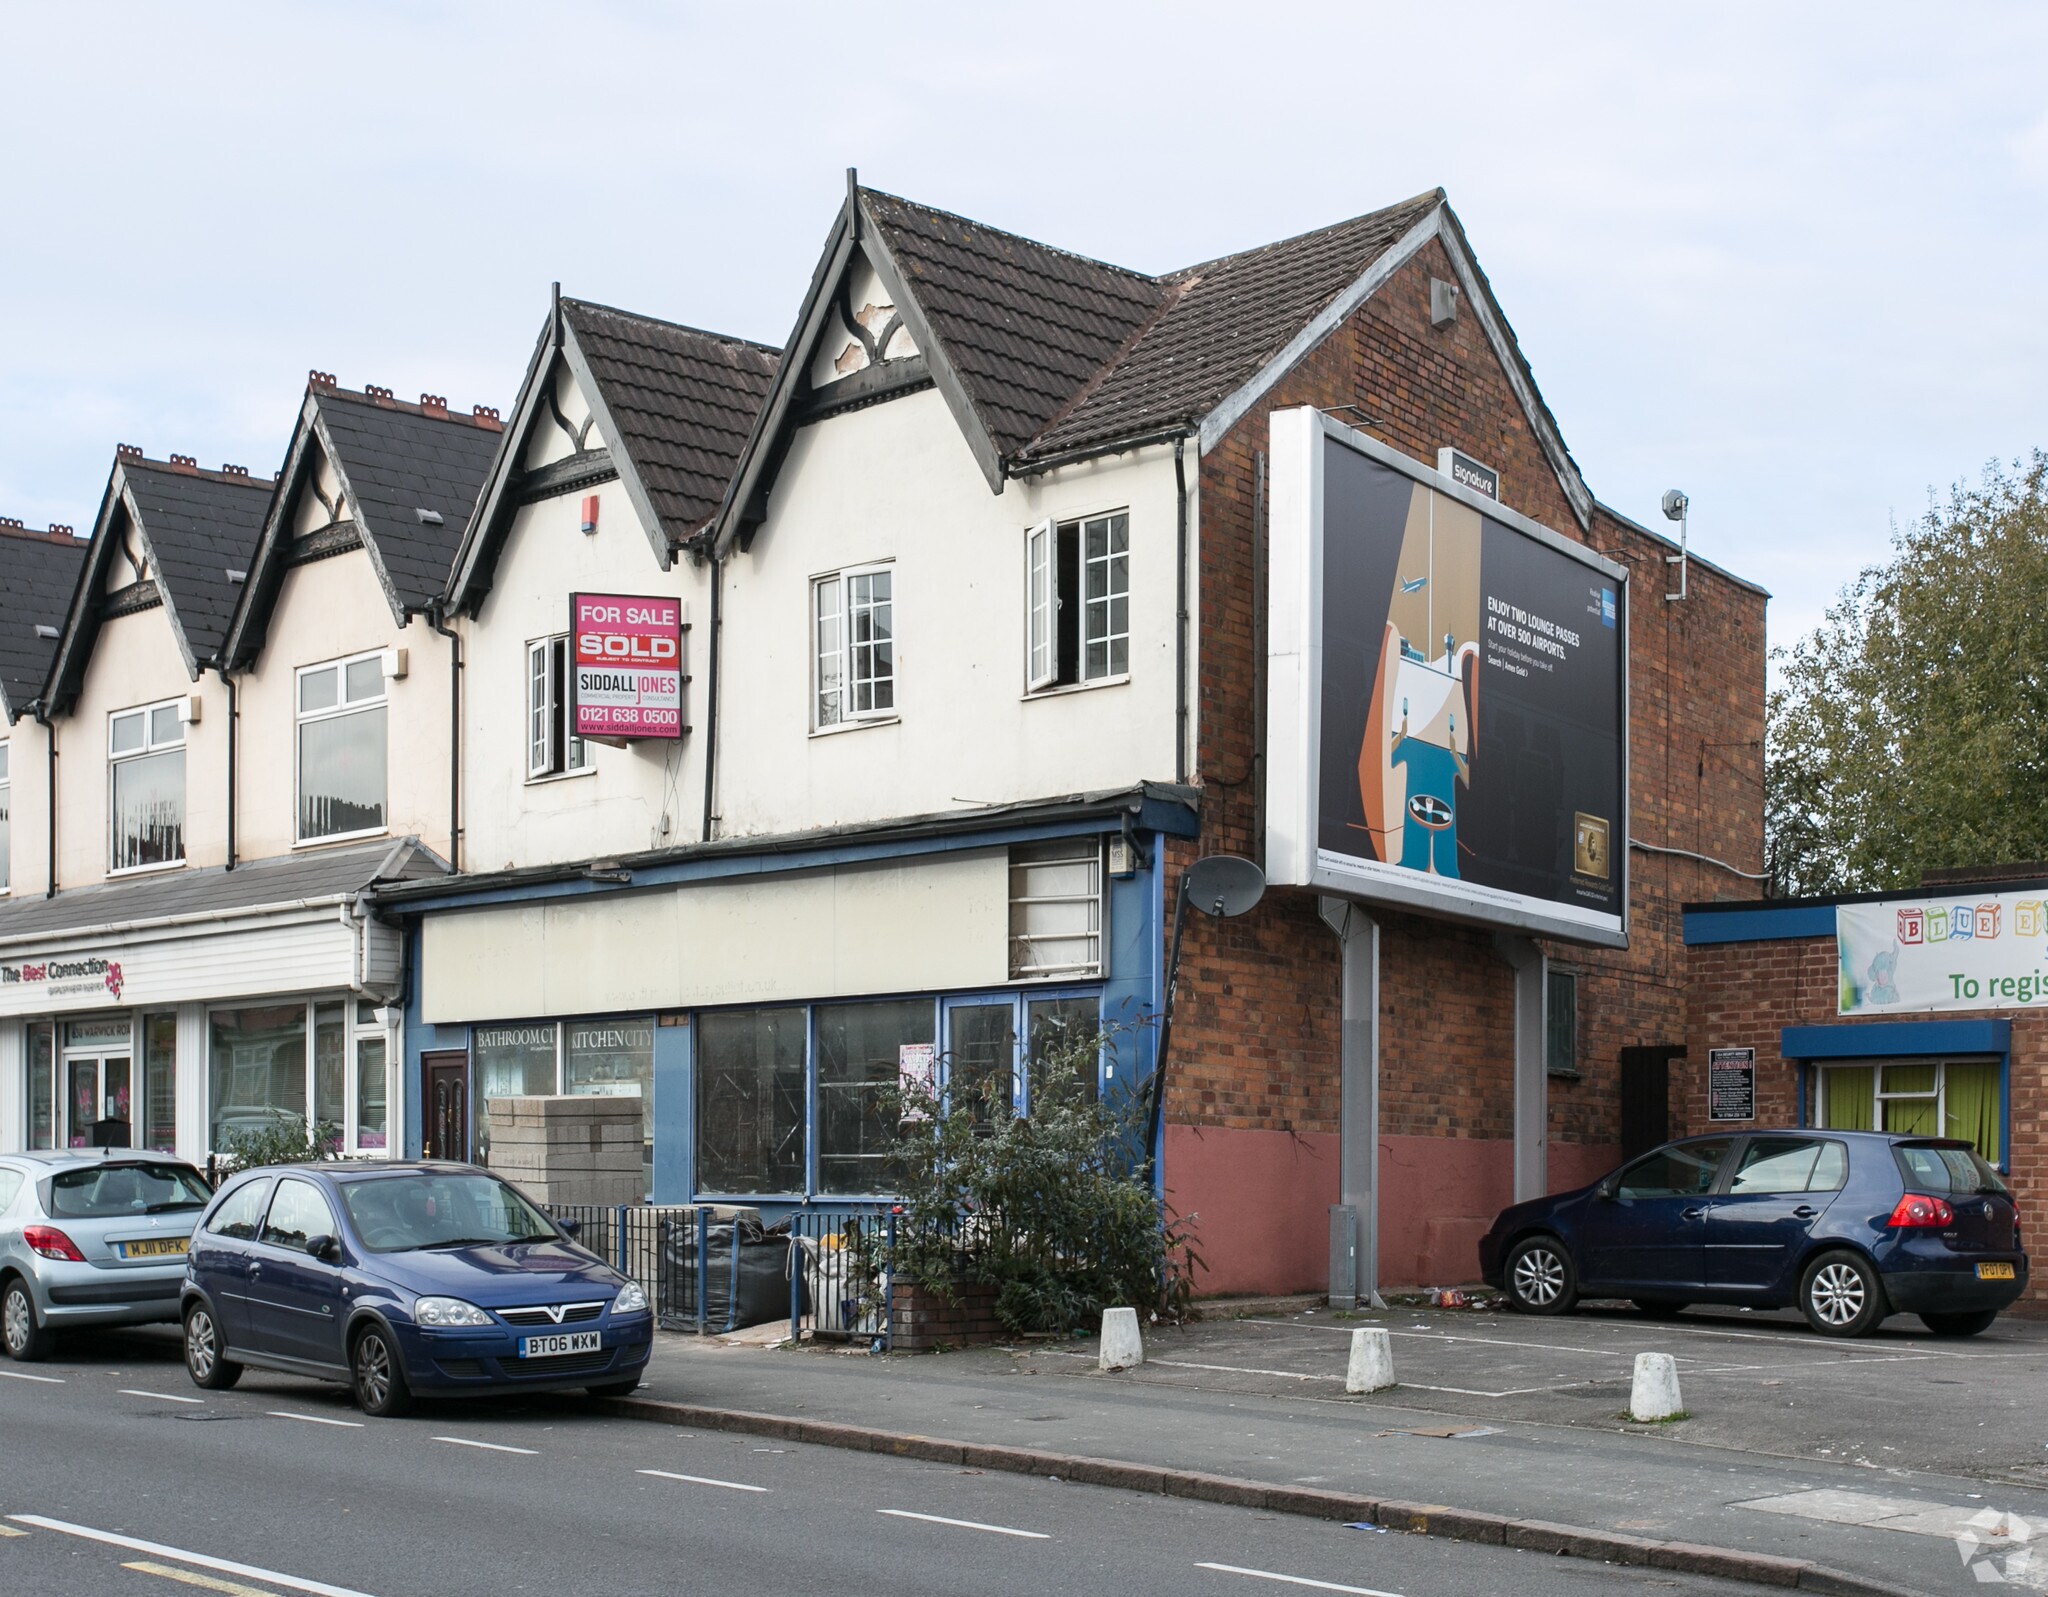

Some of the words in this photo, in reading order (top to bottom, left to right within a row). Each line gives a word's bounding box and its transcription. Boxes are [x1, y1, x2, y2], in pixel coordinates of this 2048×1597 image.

[1455, 464, 1492, 493] signature
[580, 605, 621, 624] FOR
[626, 607, 675, 626] SALE
[1487, 596, 1511, 618] ENJOY
[1511, 606, 1527, 625] TWO
[1528, 613, 1555, 637] LOUNGE
[1556, 625, 1580, 648] PASSES
[579, 634, 676, 658] SOLD
[1487, 616, 1497, 631] AT
[1498, 620, 1516, 640] OVER
[1518, 628, 1531, 646] 500
[1532, 634, 1566, 660] AIRPORTS.
[1488, 638, 1498, 651] Start
[1498, 645, 1506, 654] your
[1507, 646, 1520, 661] holiday
[1488, 654, 1502, 668] Search
[580, 673, 636, 692] SIDDALL
[580, 706, 609, 722] 0121
[612, 708, 639, 723] 638
[643, 710, 677, 724] 0500
[581, 723, 677, 734] www.siddalljones.com
[1902, 908, 1996, 941] BLUE
[2, 966, 21, 983] The
[22, 962, 47, 982] Best
[48, 958, 108, 979] Connection
[1949, 974, 1979, 999] To
[116, 1024, 131, 1036] ROA
[131, 1242, 156, 1256] MJ11
[160, 1240, 184, 1253] DFK
[529, 1336, 567, 1354] BT06
[571, 1333, 598, 1350] WXW
